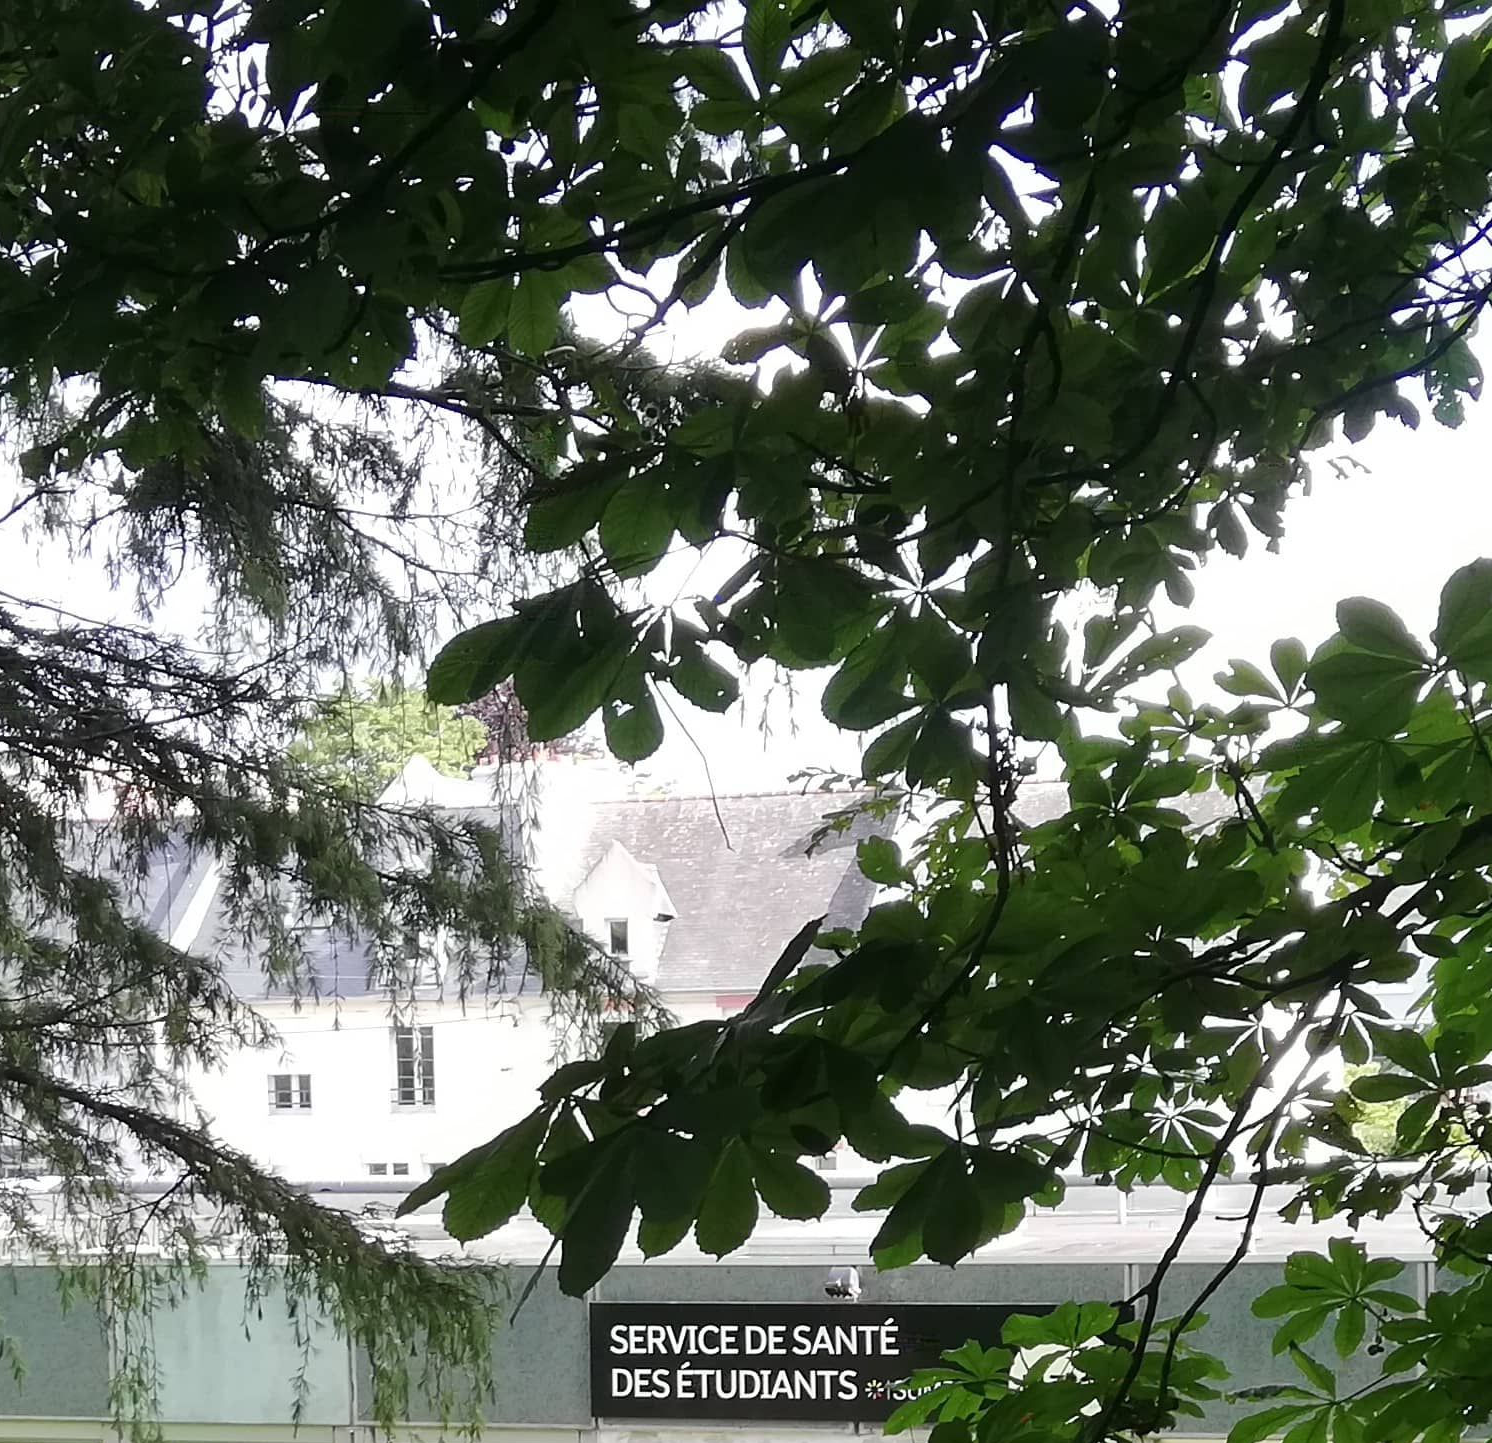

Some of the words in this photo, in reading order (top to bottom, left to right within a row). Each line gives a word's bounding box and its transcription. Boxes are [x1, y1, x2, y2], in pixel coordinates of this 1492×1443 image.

[609, 1324, 740, 1355] SERVICE
[744, 1325, 788, 1356] DE
[791, 1317, 901, 1356] SANTÉ
[611, 1367, 672, 1399] DES
[676, 1361, 858, 1400] ÉTUDIANTS
